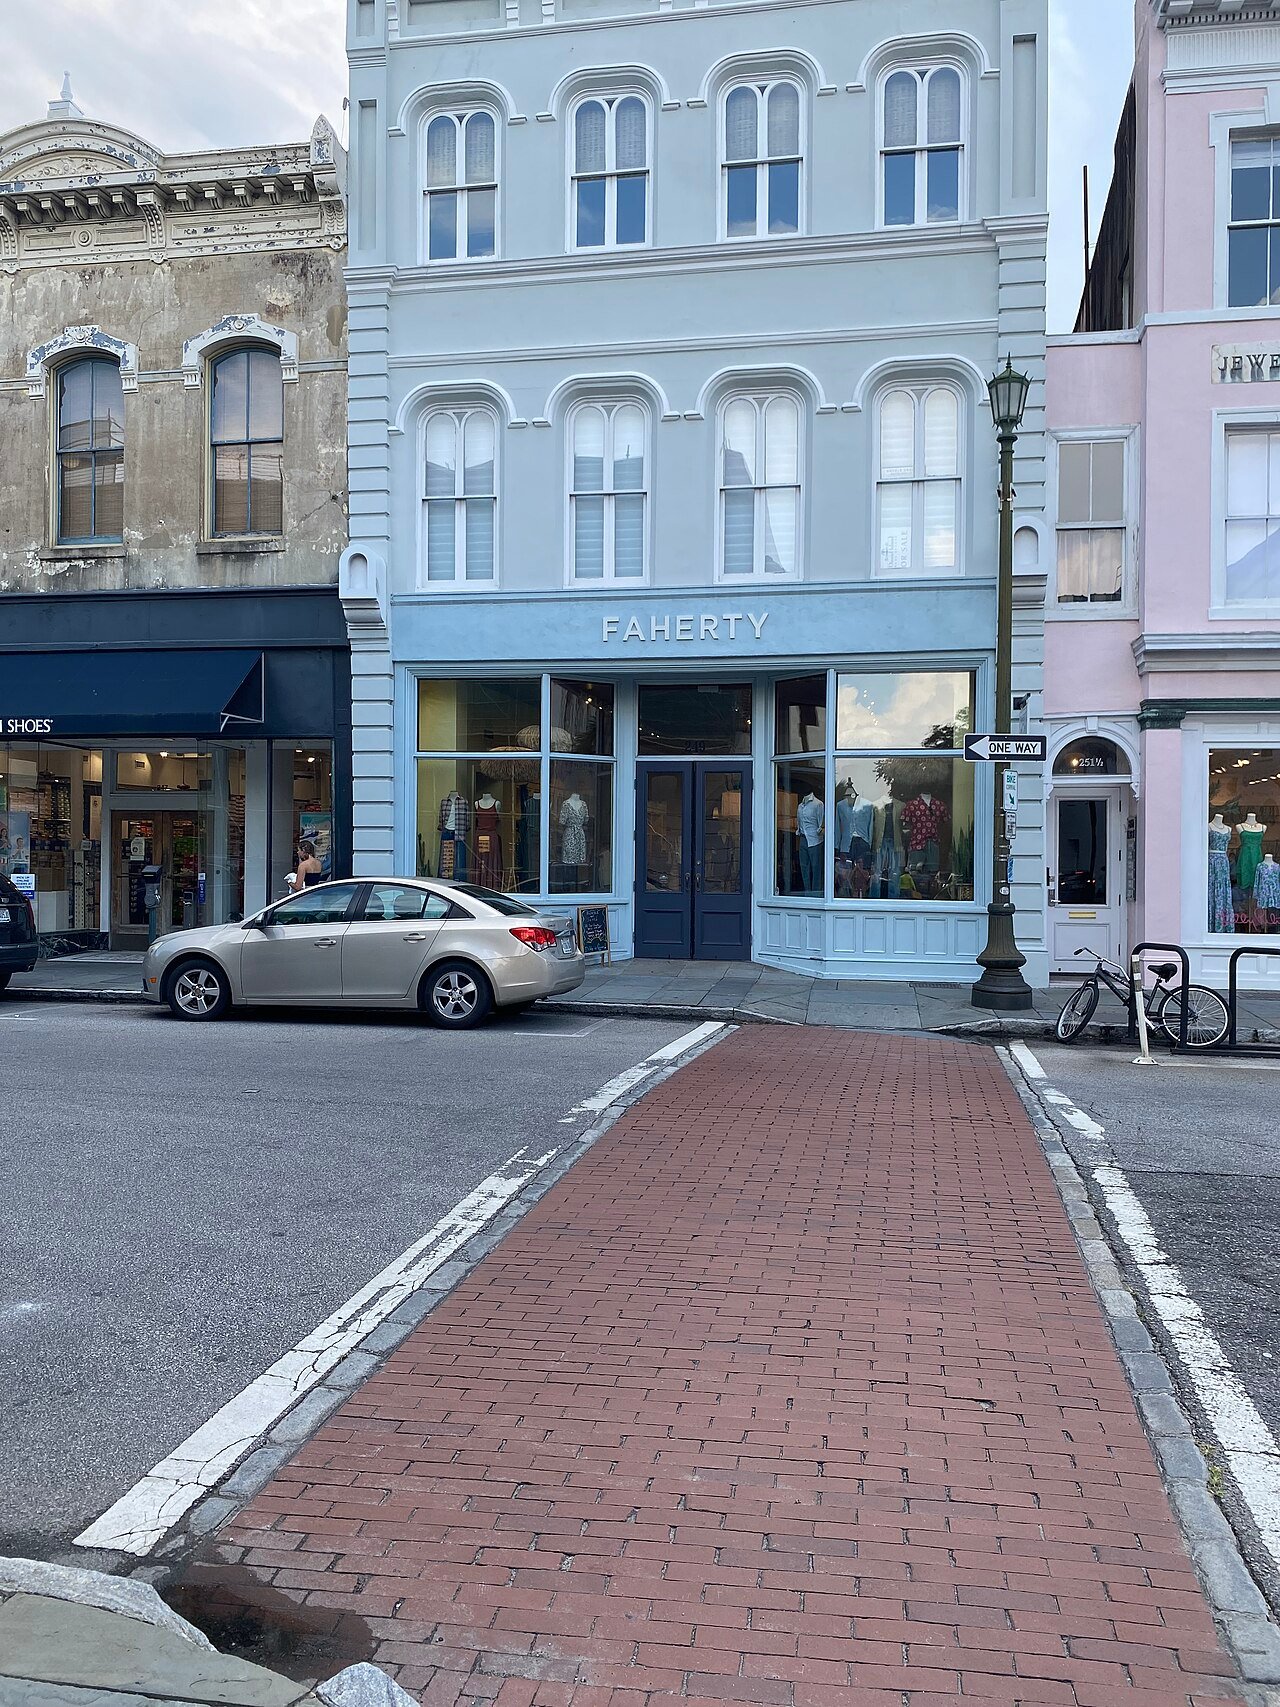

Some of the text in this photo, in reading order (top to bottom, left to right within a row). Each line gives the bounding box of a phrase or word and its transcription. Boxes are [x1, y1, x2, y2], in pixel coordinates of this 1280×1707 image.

[602, 613, 769, 642] FAHERTY
[7, 718, 52, 733] SHOES
[989, 742, 1038, 753] ONE WAY
